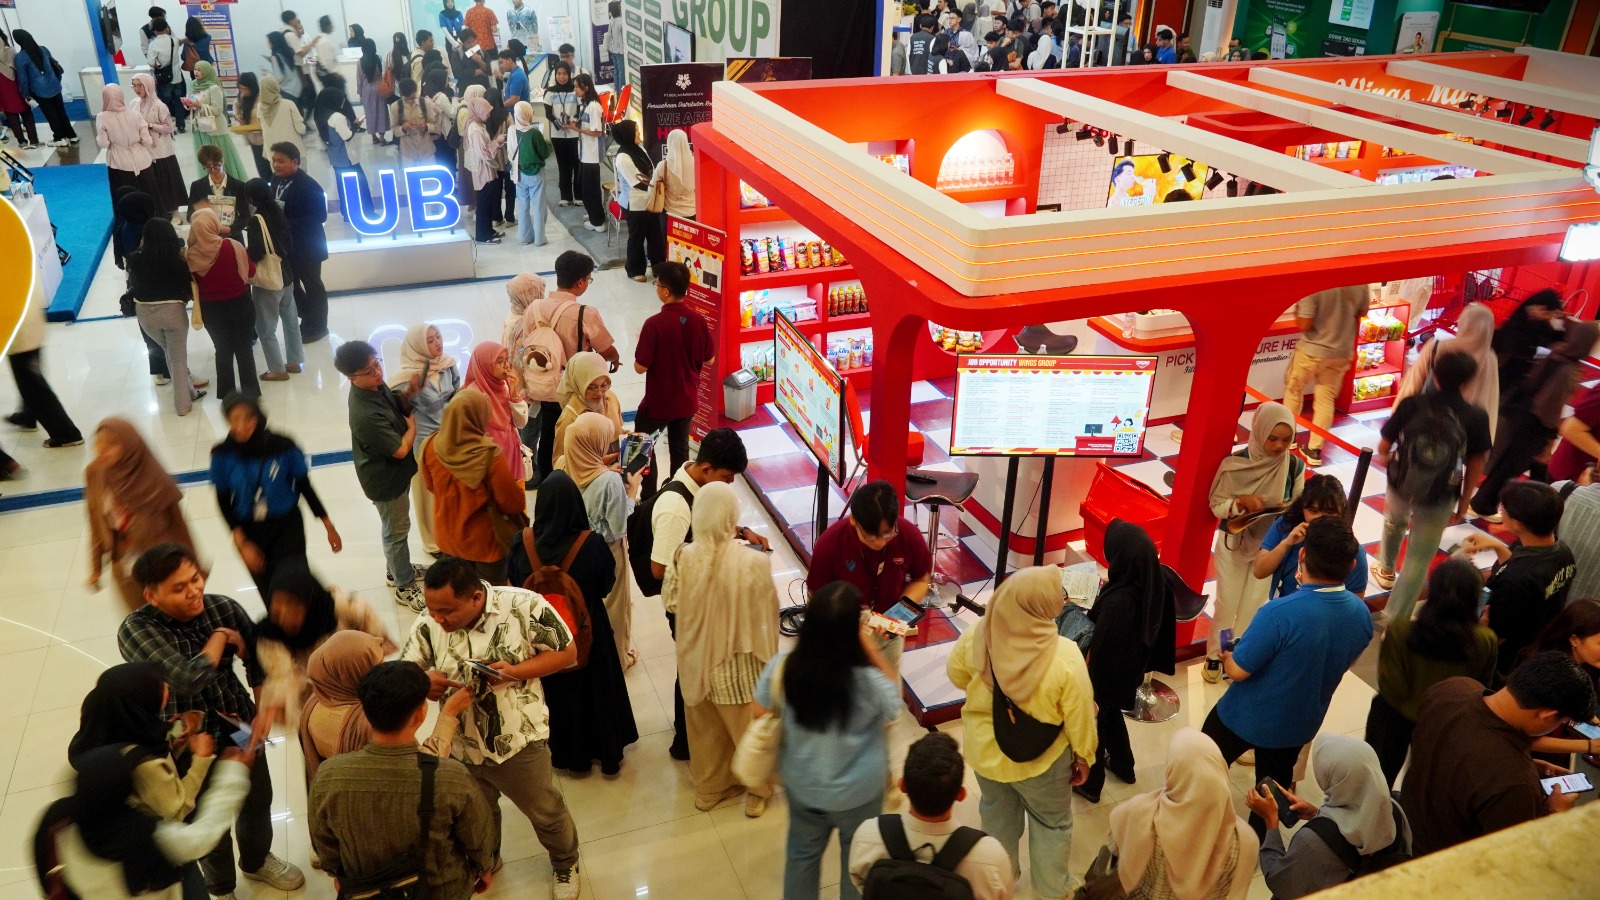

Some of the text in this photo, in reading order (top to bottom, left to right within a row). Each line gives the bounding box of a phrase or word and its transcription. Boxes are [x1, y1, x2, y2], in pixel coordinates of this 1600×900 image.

[672, 0, 771, 57] GROUP
[656, 110, 712, 126] WE ARE
[341, 164, 461, 236] UB
[1255, 338, 1300, 354] URE HE
[978, 359, 1017, 367] OPPORTUNITY
[1165, 353, 1194, 367] PICK
[1252, 352, 1292, 365] pportunities!
